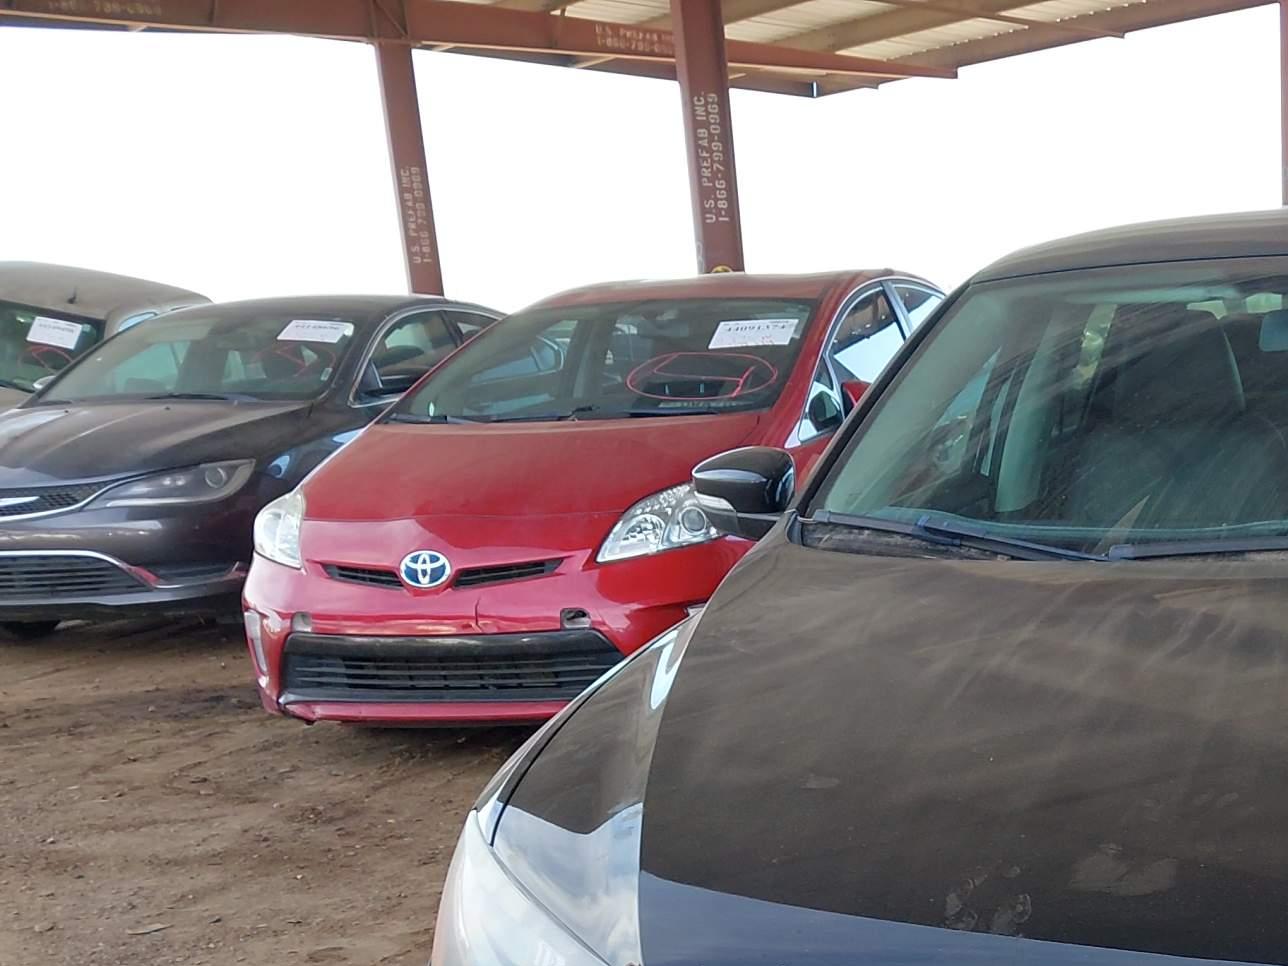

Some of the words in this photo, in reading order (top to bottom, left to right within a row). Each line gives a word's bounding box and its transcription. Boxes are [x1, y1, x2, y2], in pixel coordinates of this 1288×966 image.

[693, 91, 706, 121] INC.
[696, 128, 713, 187] PREFAB
[706, 93, 730, 222] 1-866-799-0969
[703, 194, 716, 224] U.S.
